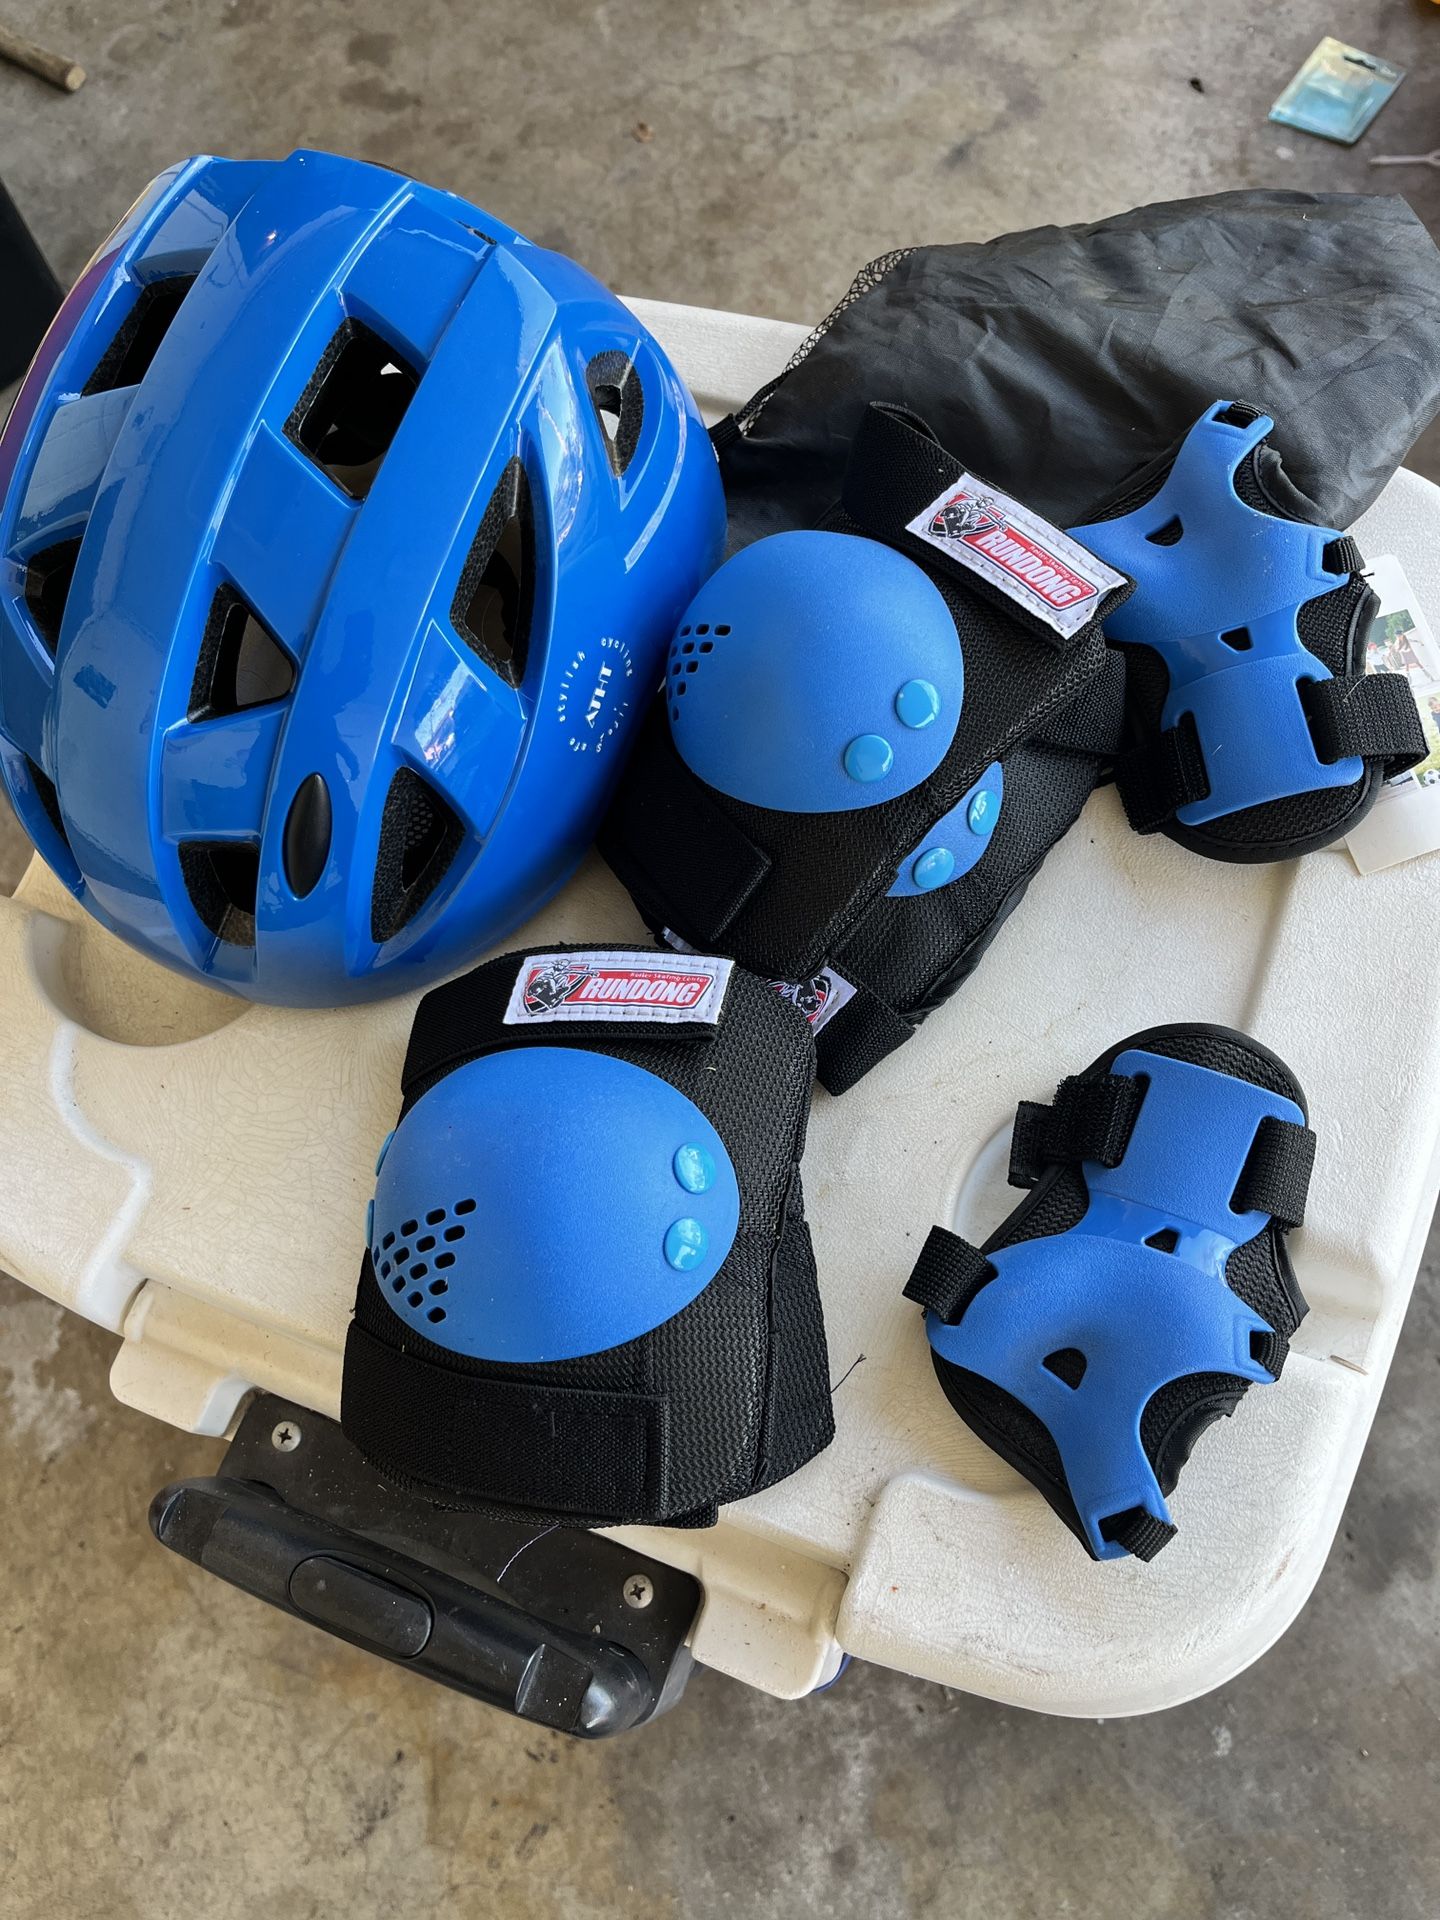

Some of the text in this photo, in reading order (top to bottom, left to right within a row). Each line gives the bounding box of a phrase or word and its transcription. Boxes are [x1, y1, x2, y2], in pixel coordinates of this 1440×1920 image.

[975, 531, 1082, 603] RUNDONG
[601, 637, 633, 677] cycling
[557, 650, 586, 722] stylish
[579, 977, 701, 1003] RUNDONG
